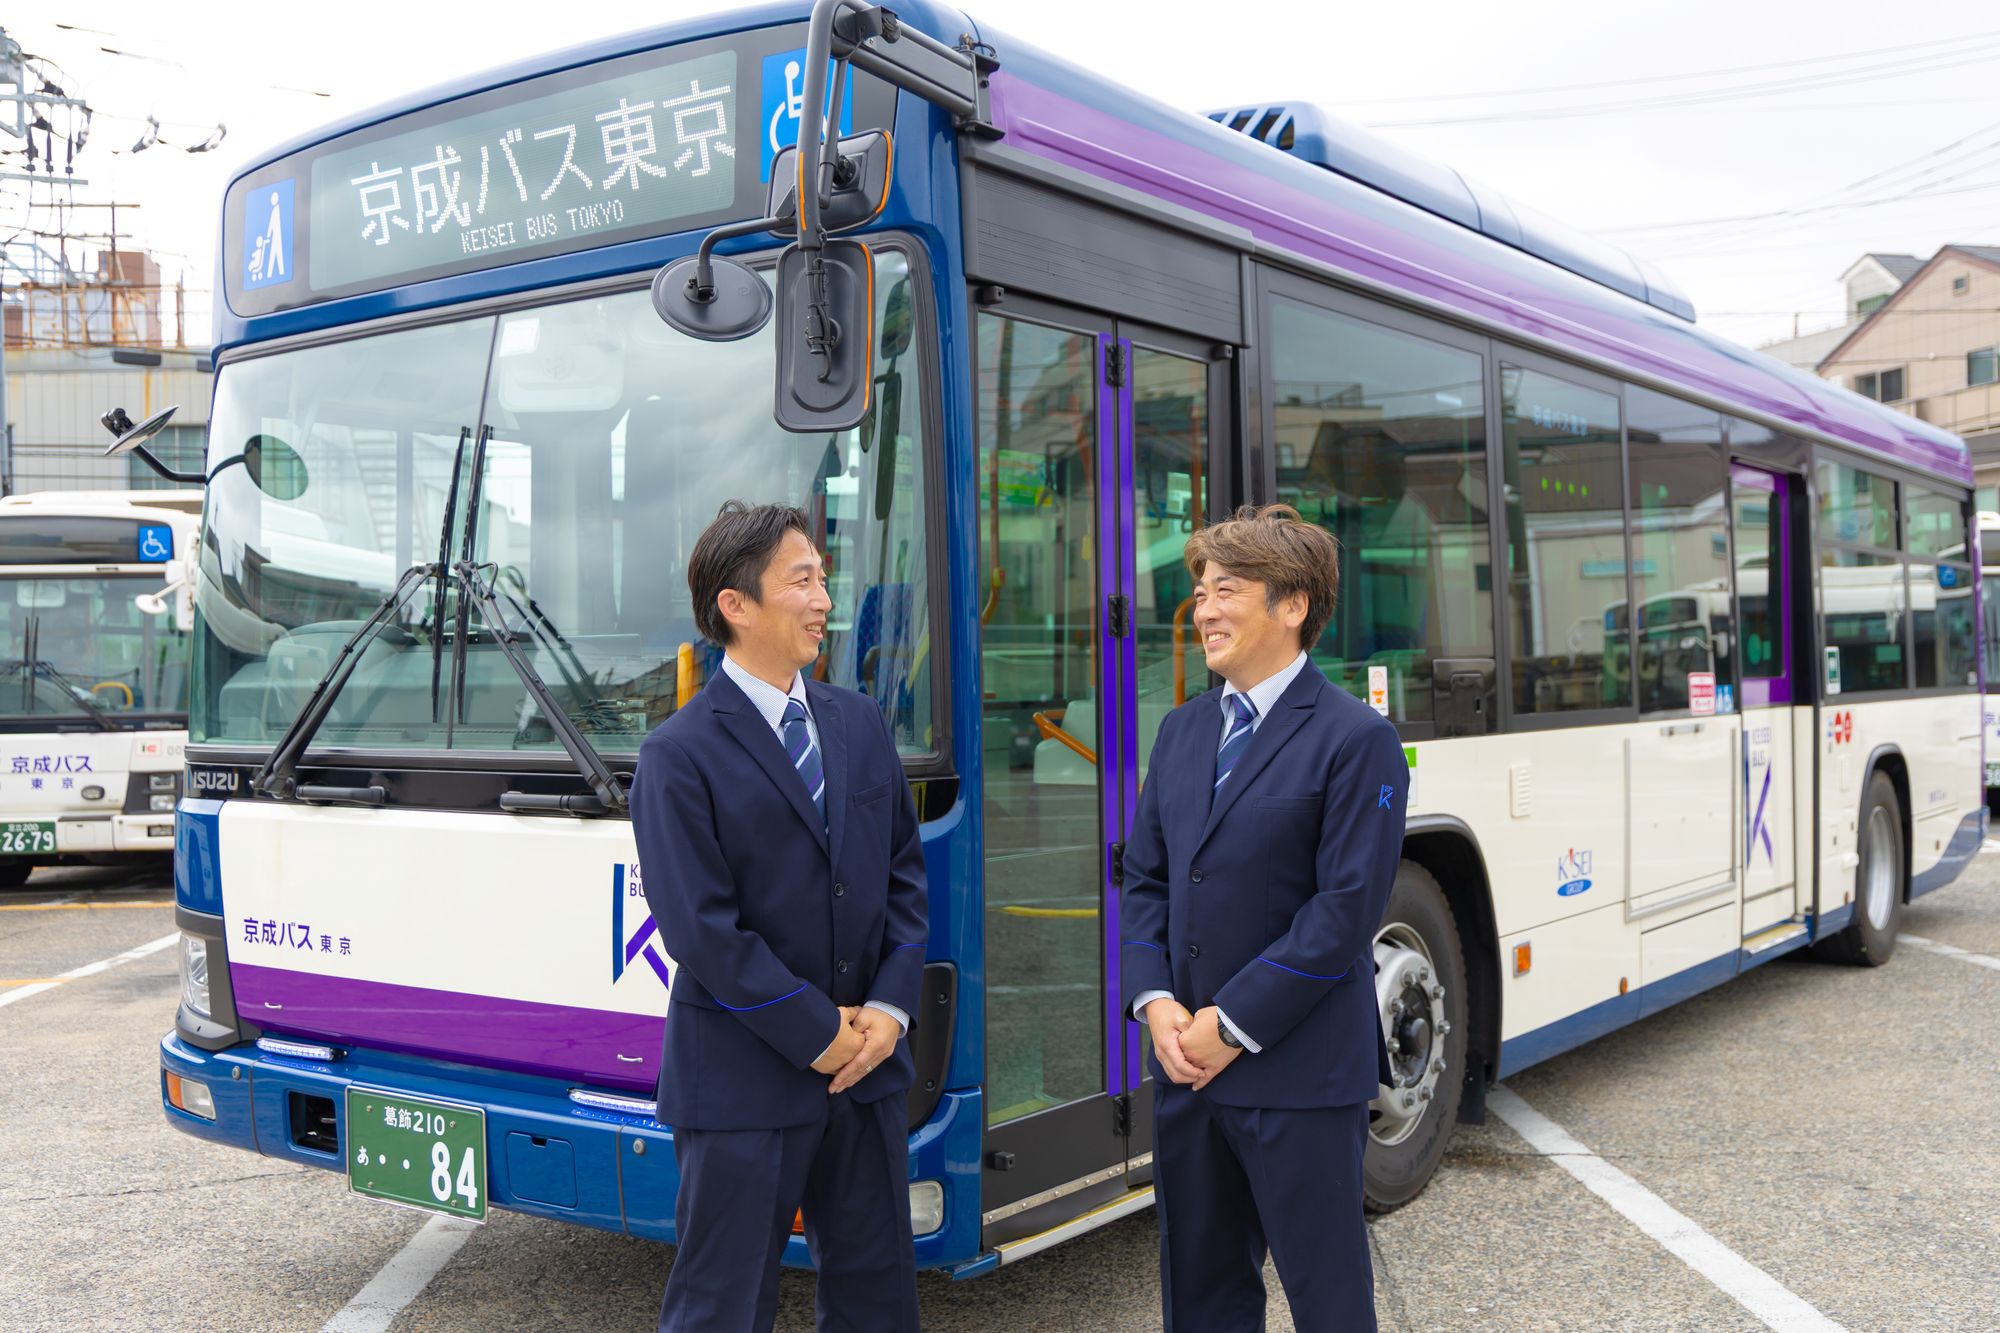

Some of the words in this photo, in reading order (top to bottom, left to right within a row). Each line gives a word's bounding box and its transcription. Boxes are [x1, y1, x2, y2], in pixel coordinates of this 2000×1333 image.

[350, 80, 736, 246] 京成バス東京
[460, 222, 516, 253] KEISEI
[525, 213, 558, 240] BUS
[566, 199, 624, 231] TOKYO
[11, 755, 93, 774] 京成バス
[31, 777, 74, 790] 東京
[193, 771, 239, 791] ISUZU
[629, 882, 646, 898] BU
[243, 917, 313, 951] 京成バス
[384, 1105, 446, 1136] 葛飾210
